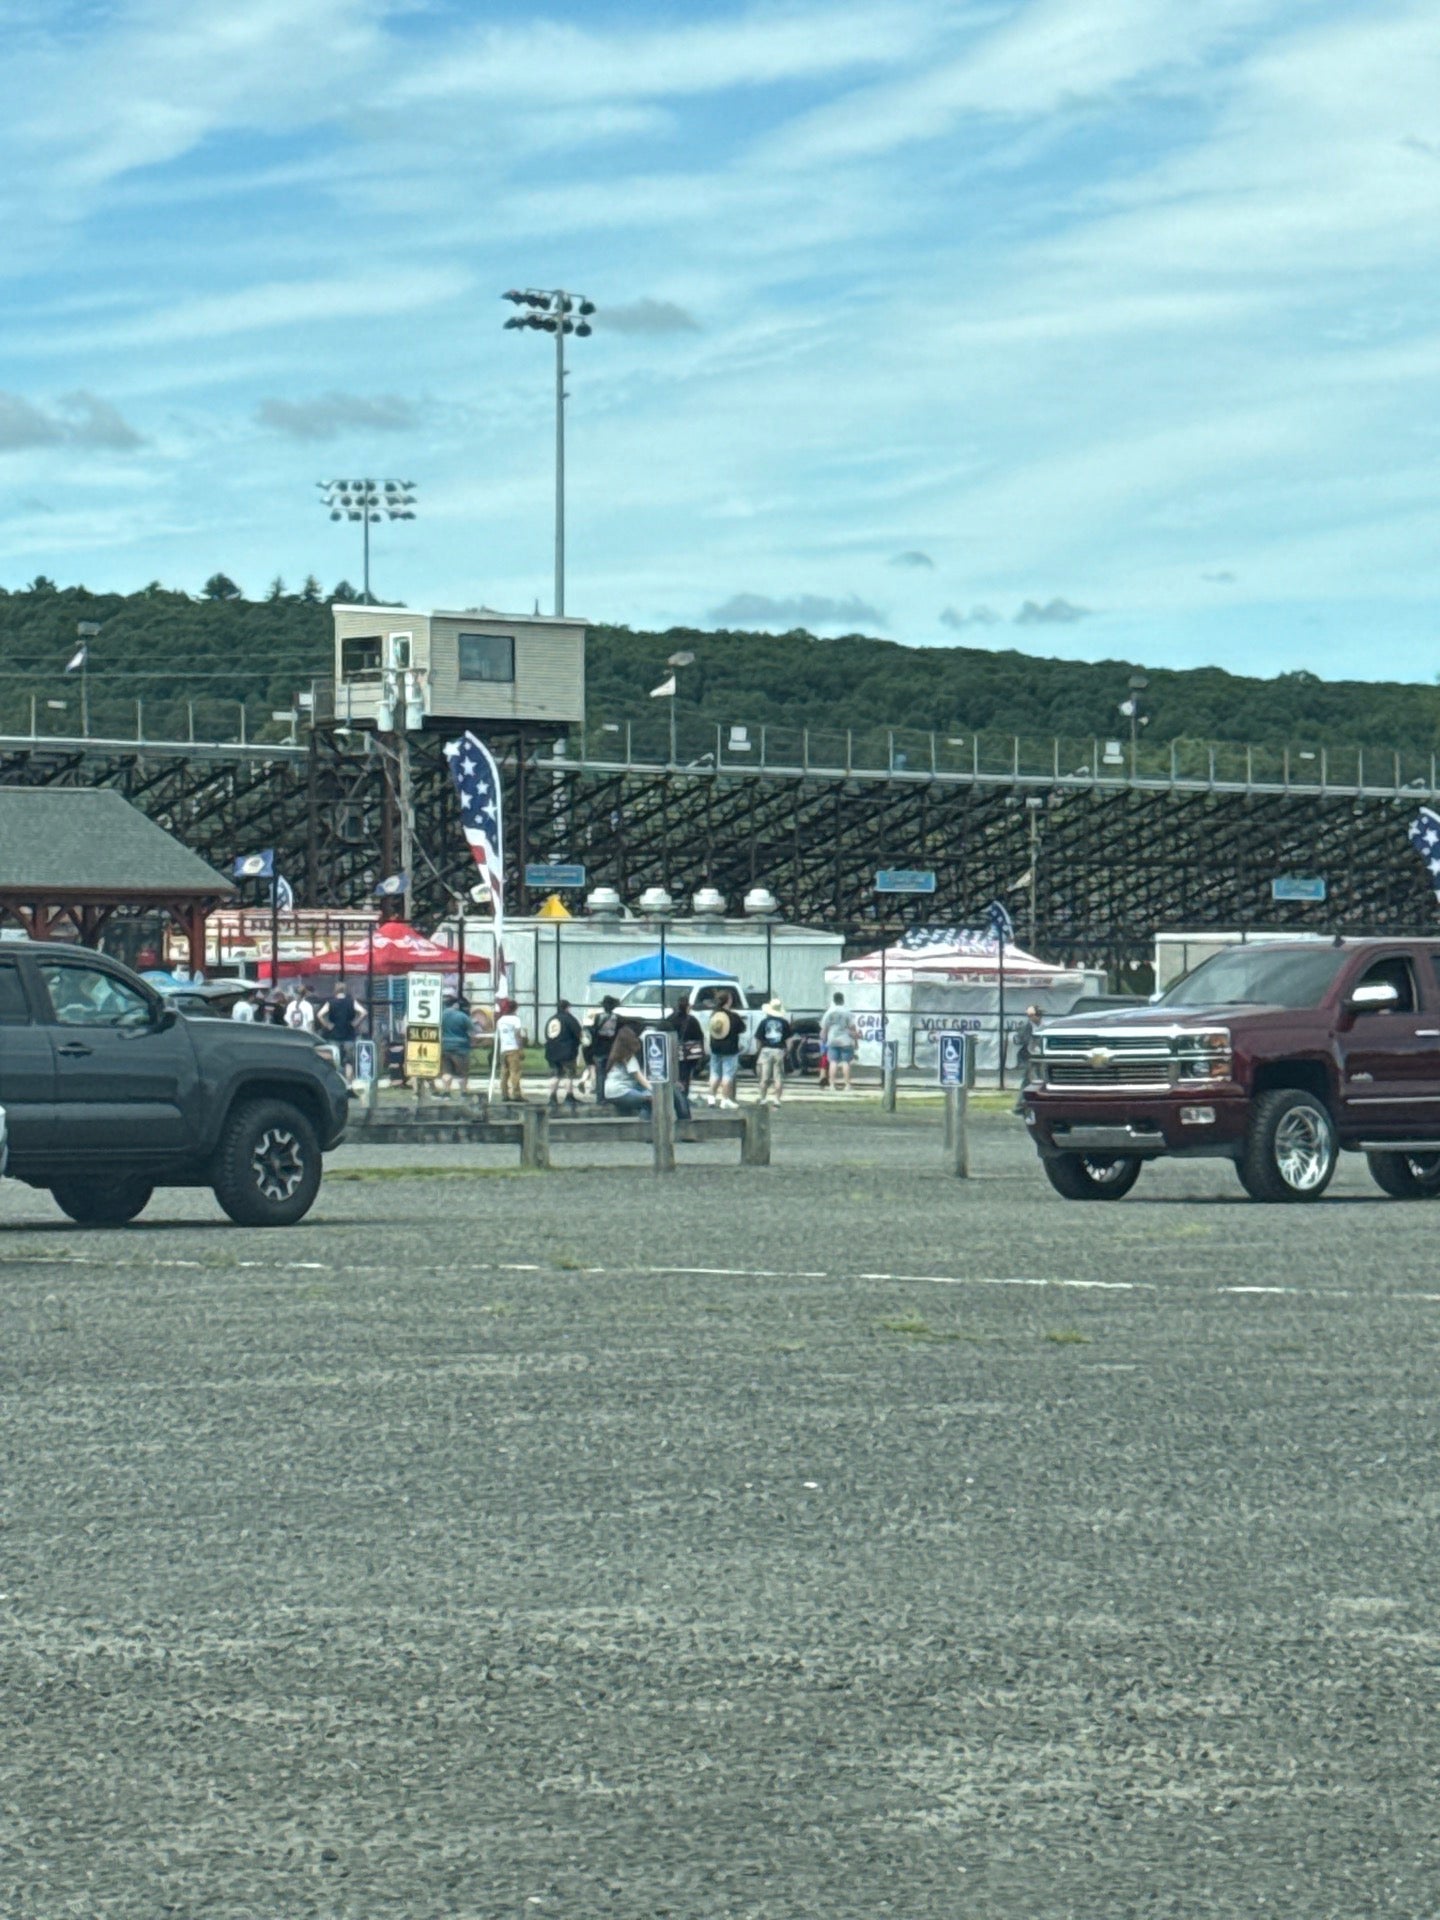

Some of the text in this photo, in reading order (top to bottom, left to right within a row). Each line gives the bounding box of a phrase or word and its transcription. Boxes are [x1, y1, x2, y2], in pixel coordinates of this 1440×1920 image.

[411, 978, 440, 987] SPEED
[413, 989, 436, 997] LIMIT
[417, 1000, 431, 1019] 5
[857, 1015, 889, 1028] GRIP
[952, 1018, 981, 1031] GRIP
[409, 1027, 438, 1039] SLOW
